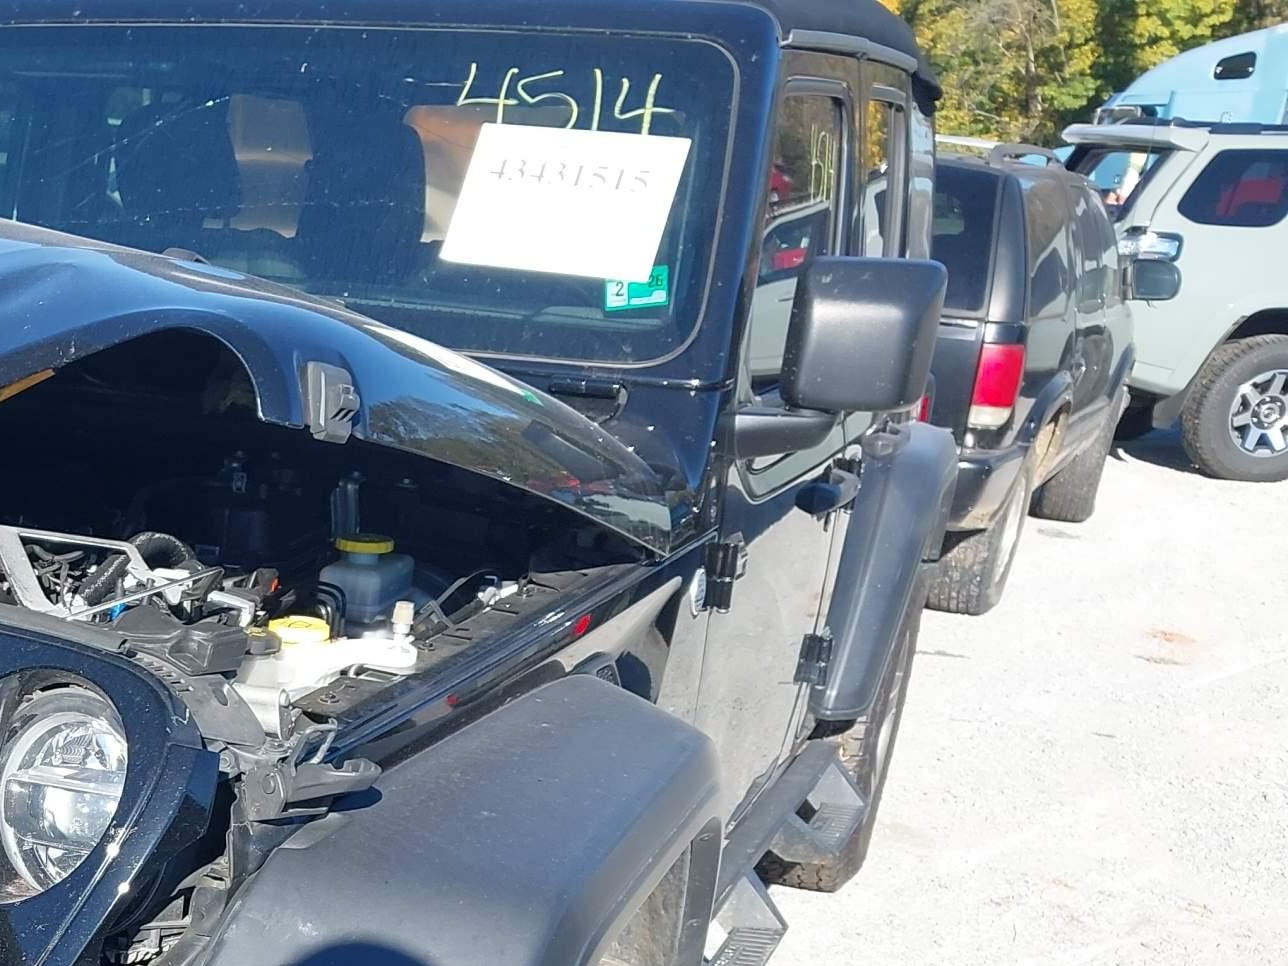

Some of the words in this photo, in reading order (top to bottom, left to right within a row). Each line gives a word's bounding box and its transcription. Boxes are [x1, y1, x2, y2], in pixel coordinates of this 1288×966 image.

[456, 62, 675, 136] 4514
[488, 158, 651, 193] 43431515
[615, 281, 624, 297] 2
